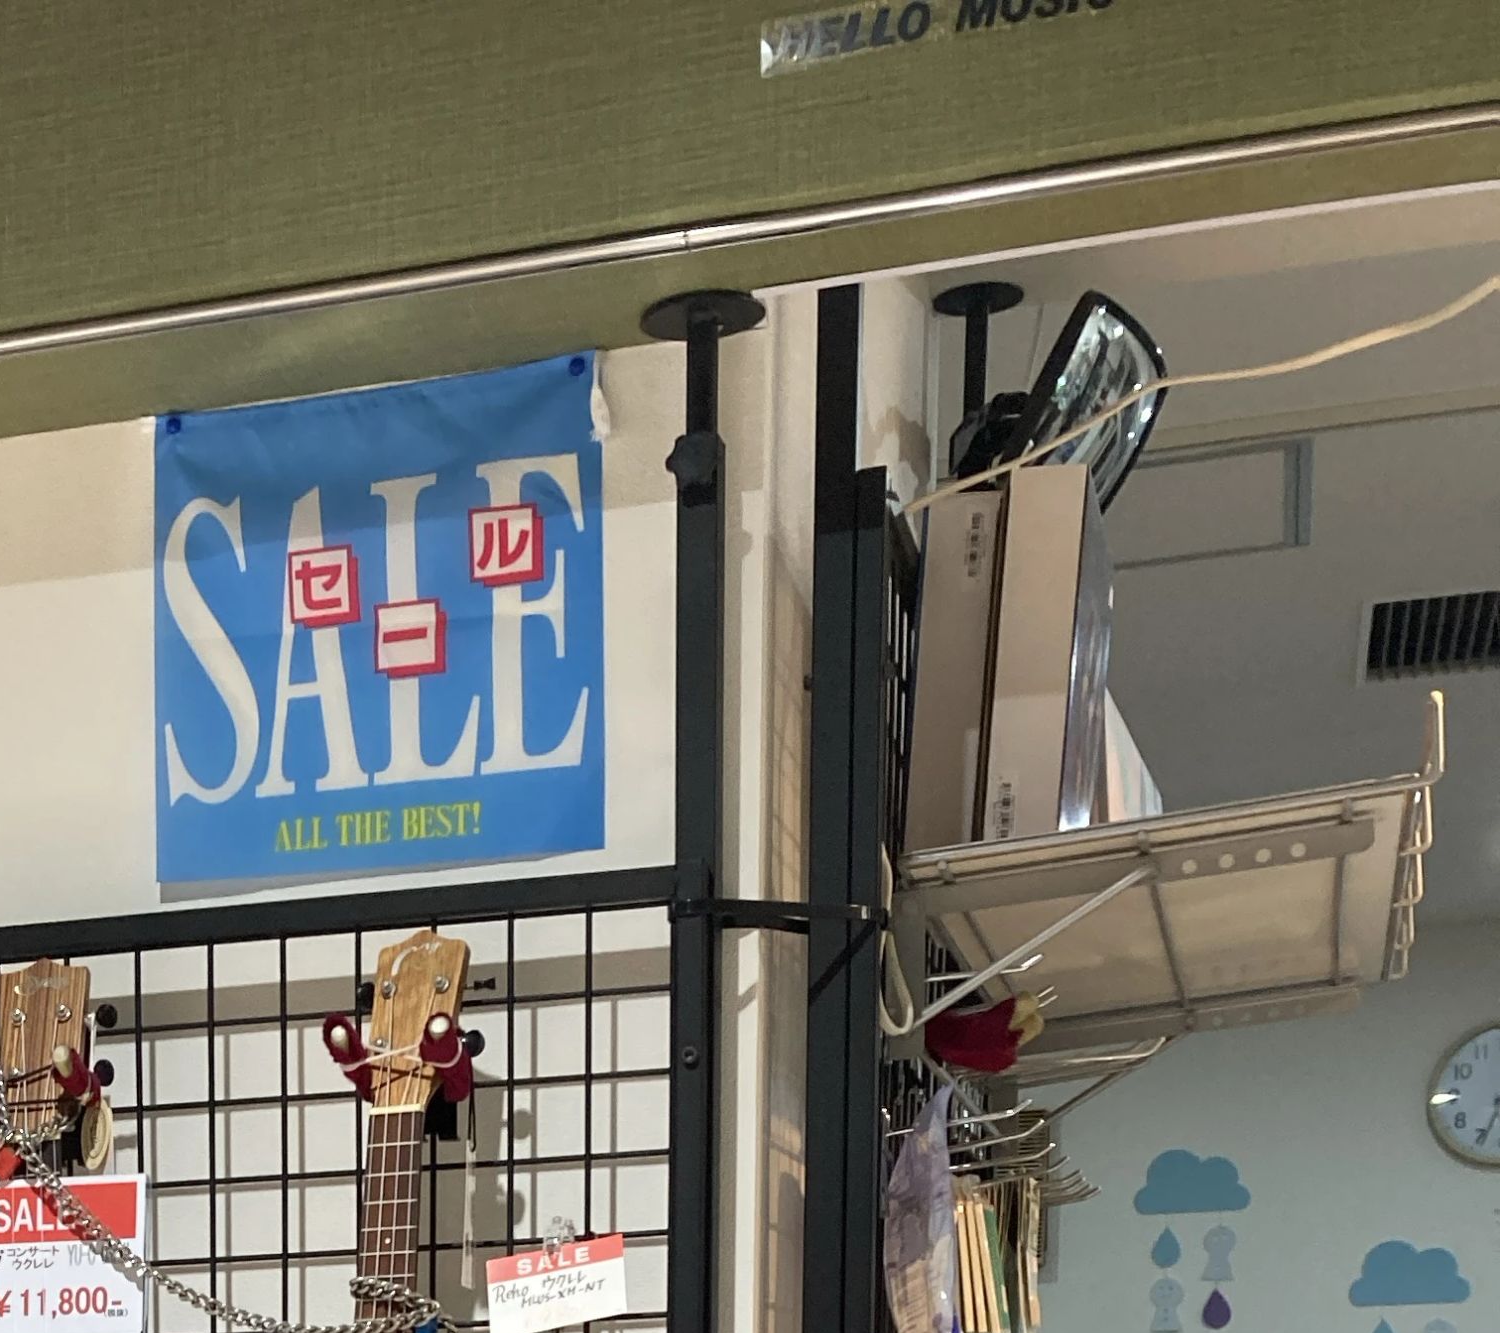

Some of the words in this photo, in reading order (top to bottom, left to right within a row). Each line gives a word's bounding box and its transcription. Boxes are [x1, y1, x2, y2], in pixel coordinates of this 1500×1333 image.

[164, 453, 589, 806] SALE
[275, 818, 328, 852] ALL
[336, 810, 392, 846] THE
[402, 801, 482, 839] BEST!
[6, 1247, 60, 1258] コンサート
[11, 1257, 55, 1271] ウクレレ
[516, 1246, 591, 1276] SALE
